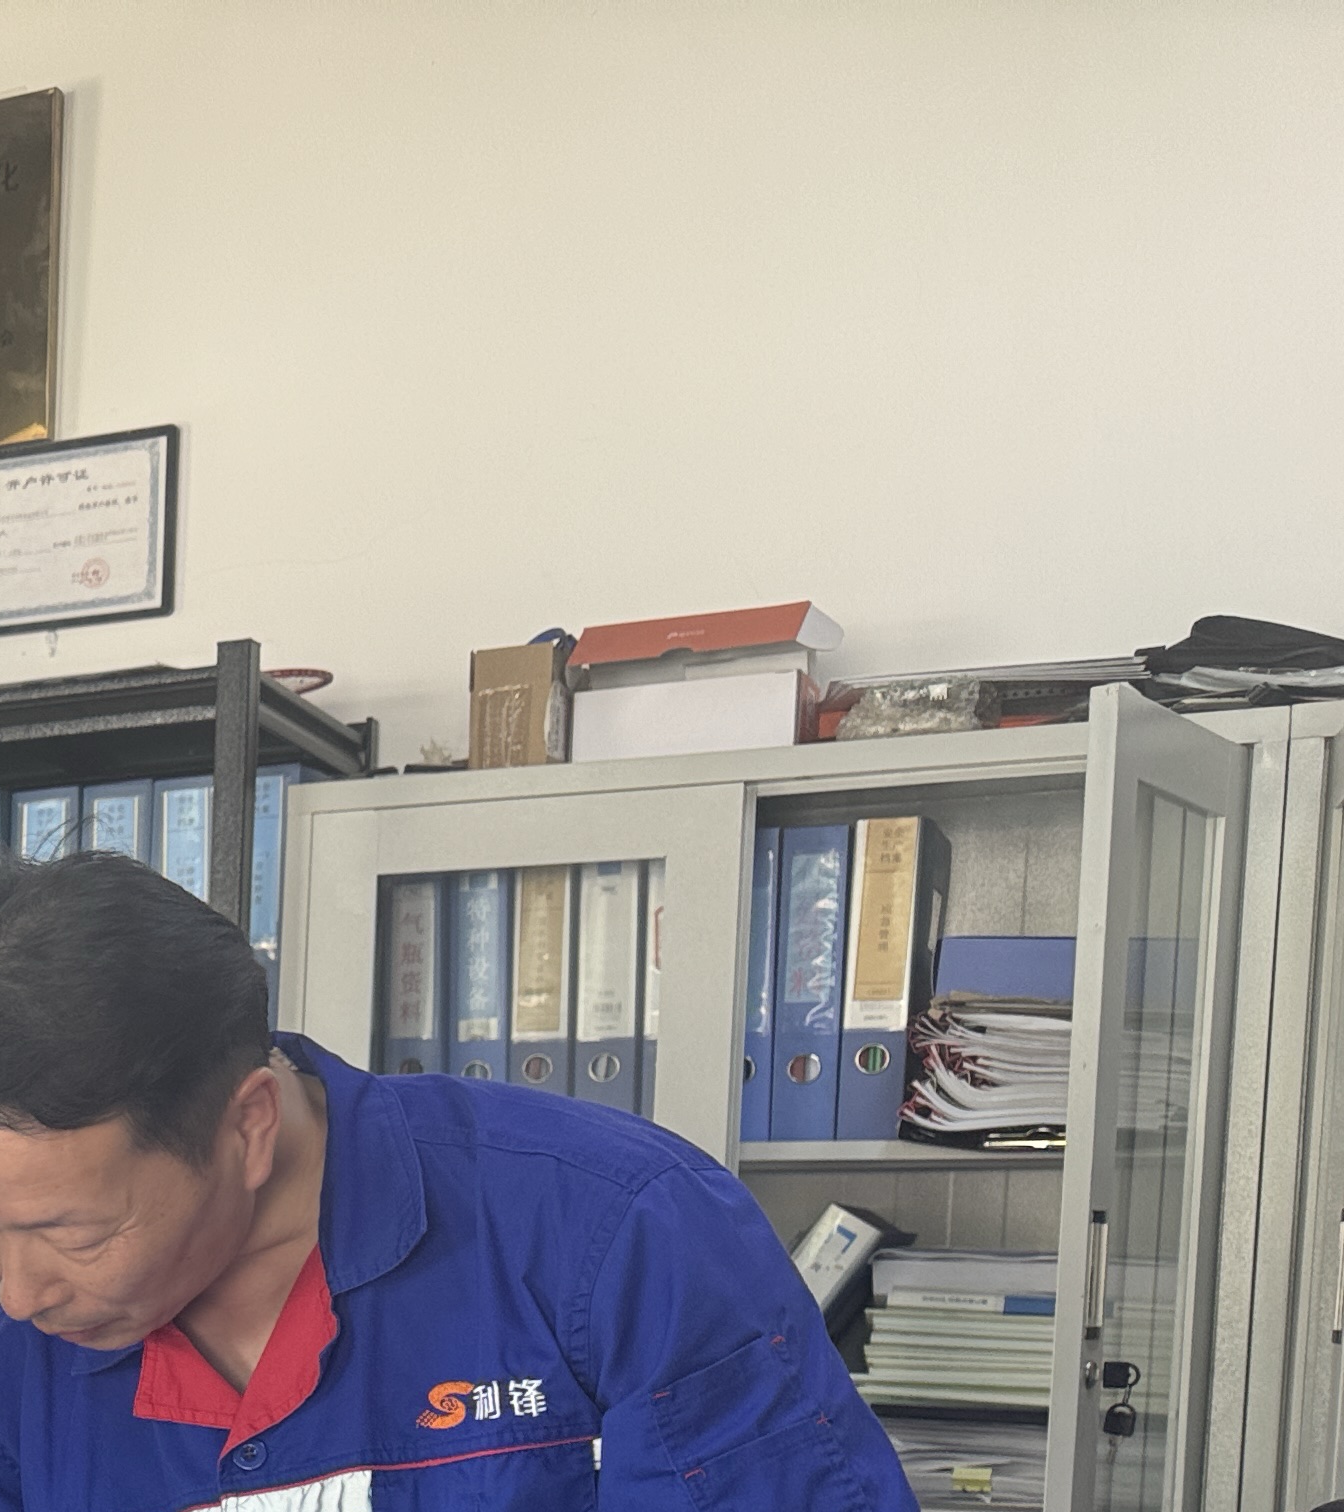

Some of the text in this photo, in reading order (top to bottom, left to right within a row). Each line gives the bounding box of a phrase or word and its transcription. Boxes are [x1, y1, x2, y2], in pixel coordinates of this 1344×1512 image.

[468, 897, 491, 1012] 特种设备
[472, 1379, 548, 1420] 利锋
